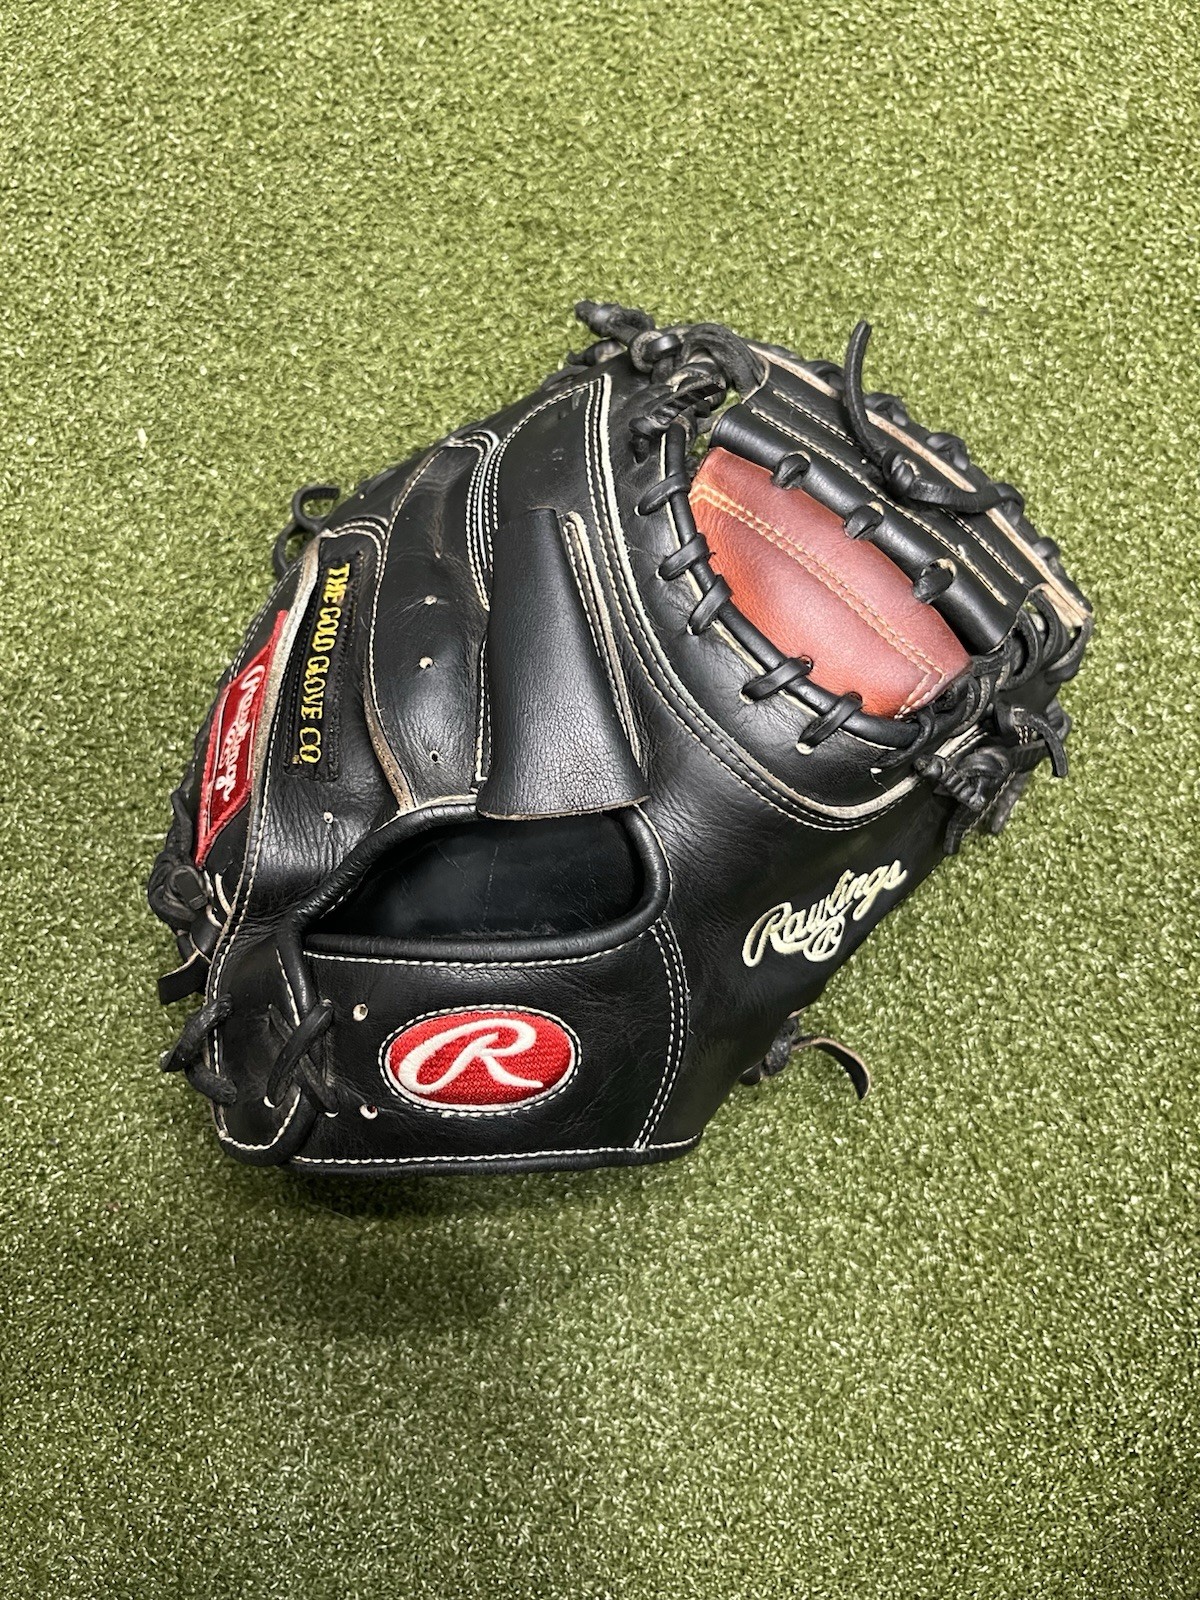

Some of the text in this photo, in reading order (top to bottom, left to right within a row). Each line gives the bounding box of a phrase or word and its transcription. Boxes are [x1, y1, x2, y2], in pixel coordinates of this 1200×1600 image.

[322, 562, 351, 604] THE
[311, 606, 342, 652] GOLD
[301, 655, 330, 720] GLOVE
[741, 859, 908, 968] Rawlings
[398, 1017, 544, 1095] R
